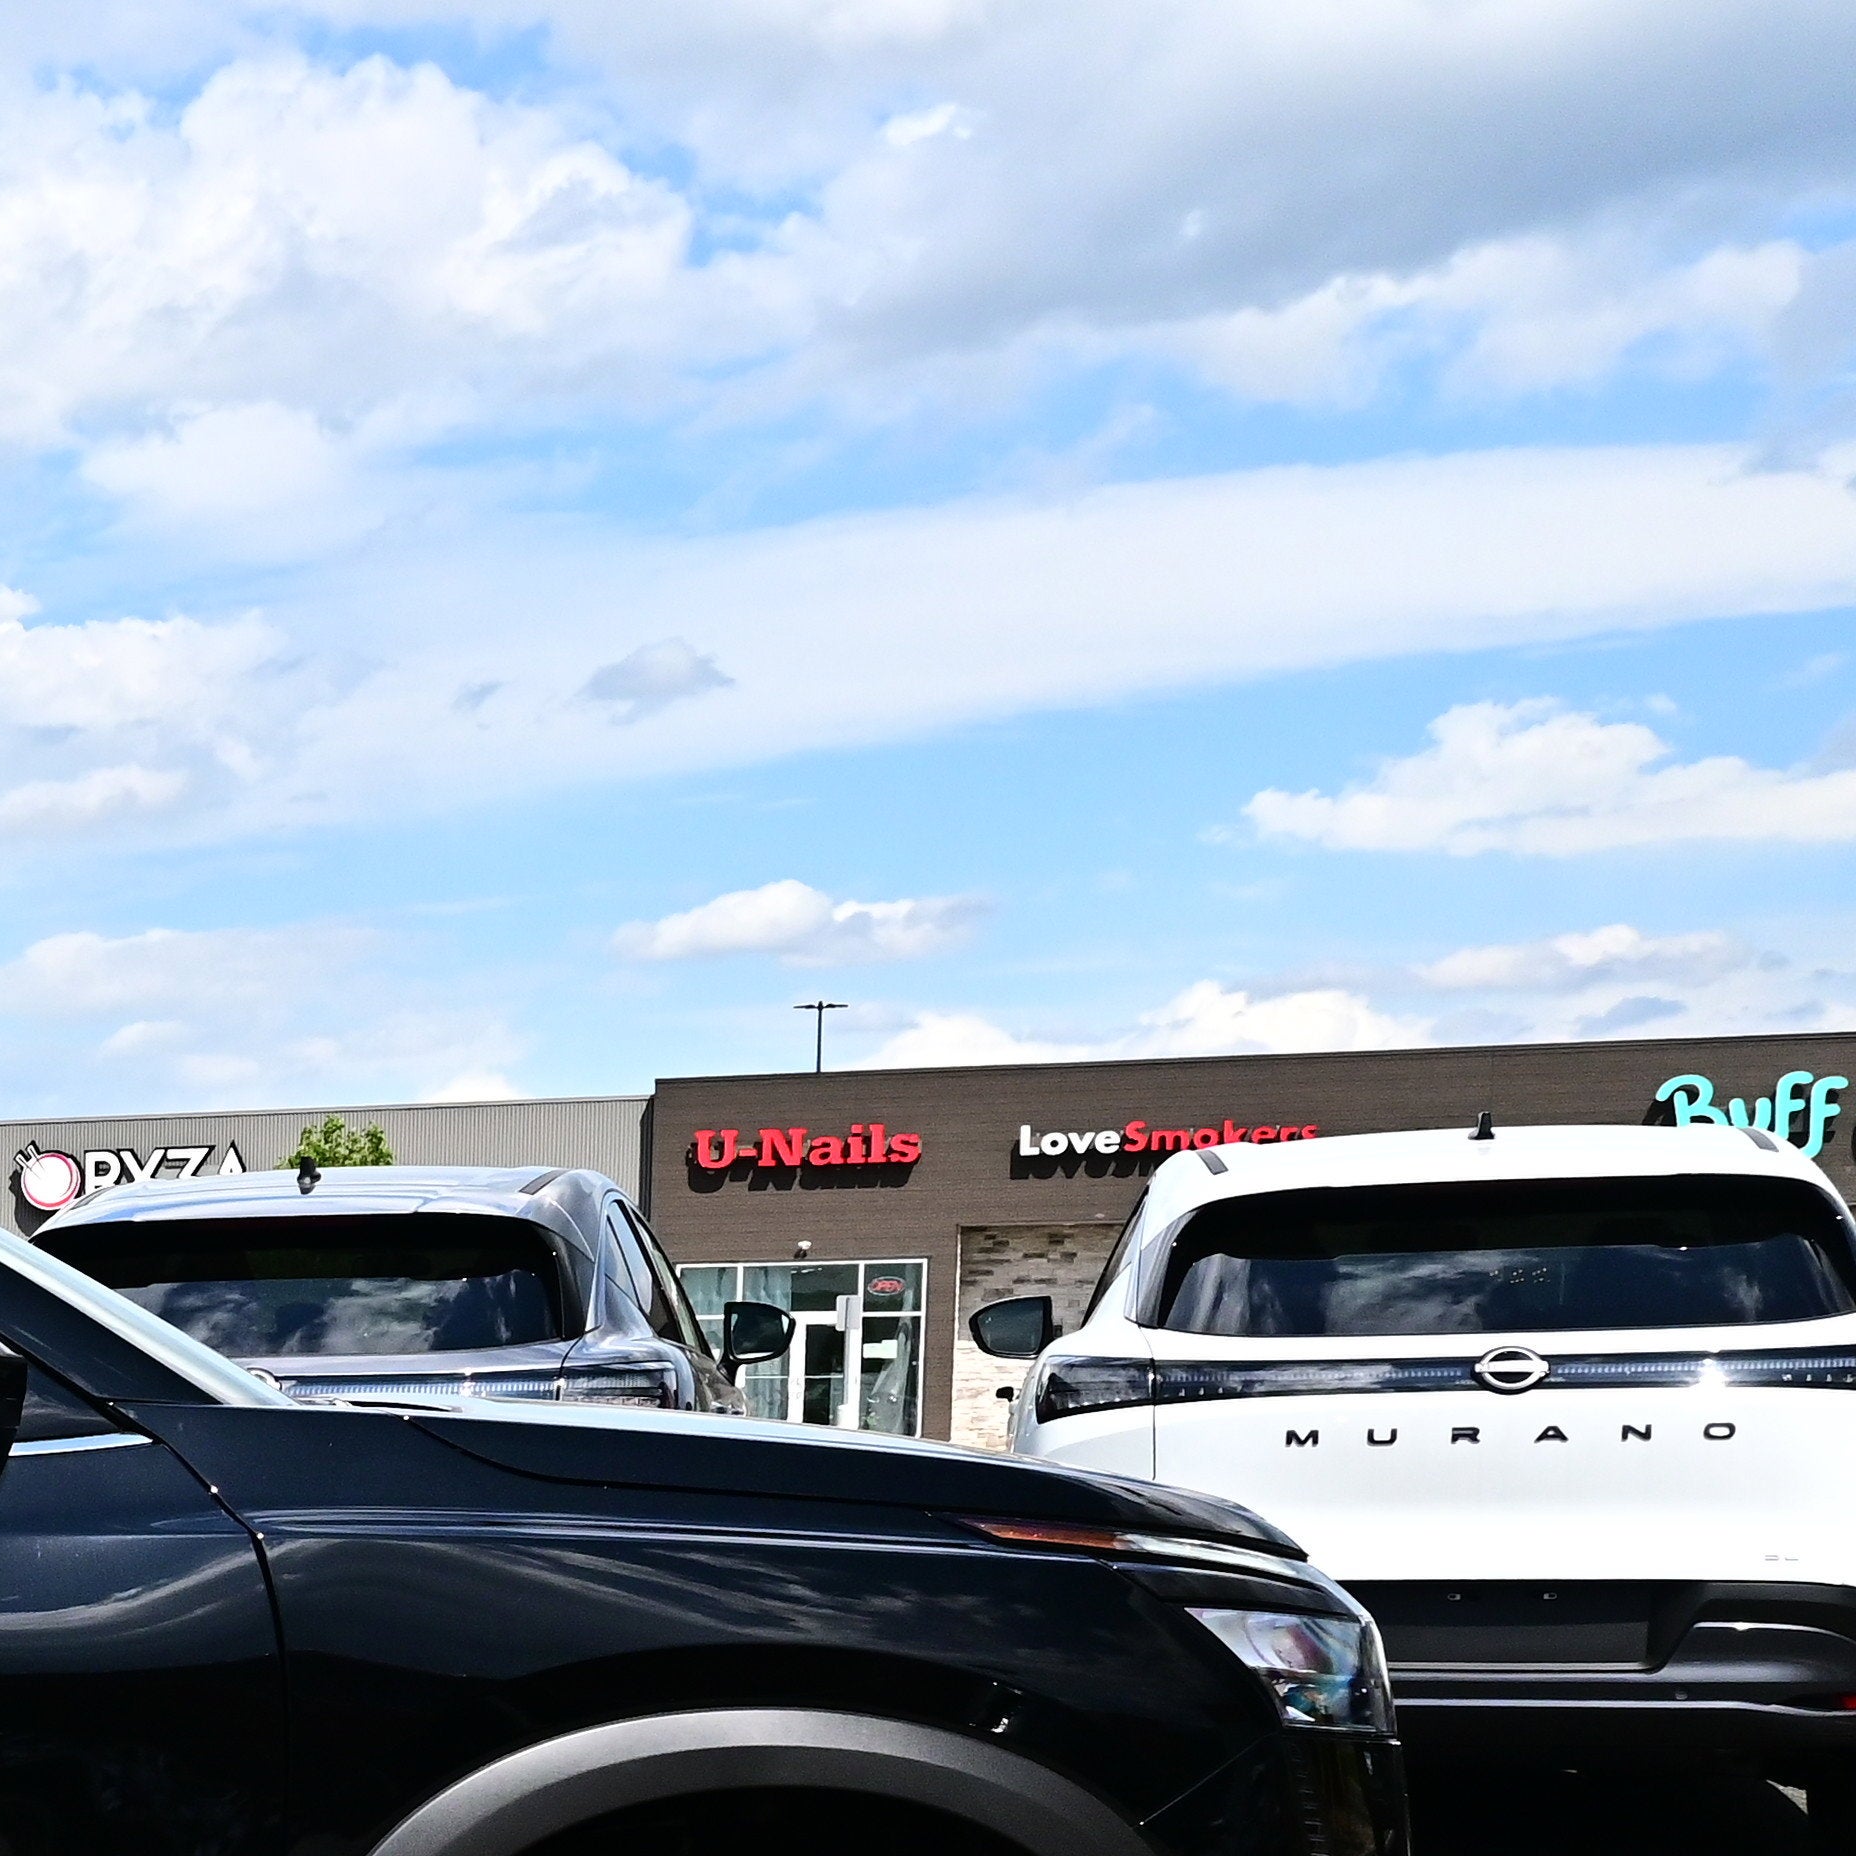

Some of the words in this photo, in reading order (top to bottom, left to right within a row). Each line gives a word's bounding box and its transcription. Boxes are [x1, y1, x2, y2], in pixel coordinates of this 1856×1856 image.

[1655, 1070, 1850, 1160] Buff
[694, 1123, 922, 1169] U-Nails
[1284, 1421, 1737, 1449] MURANO
